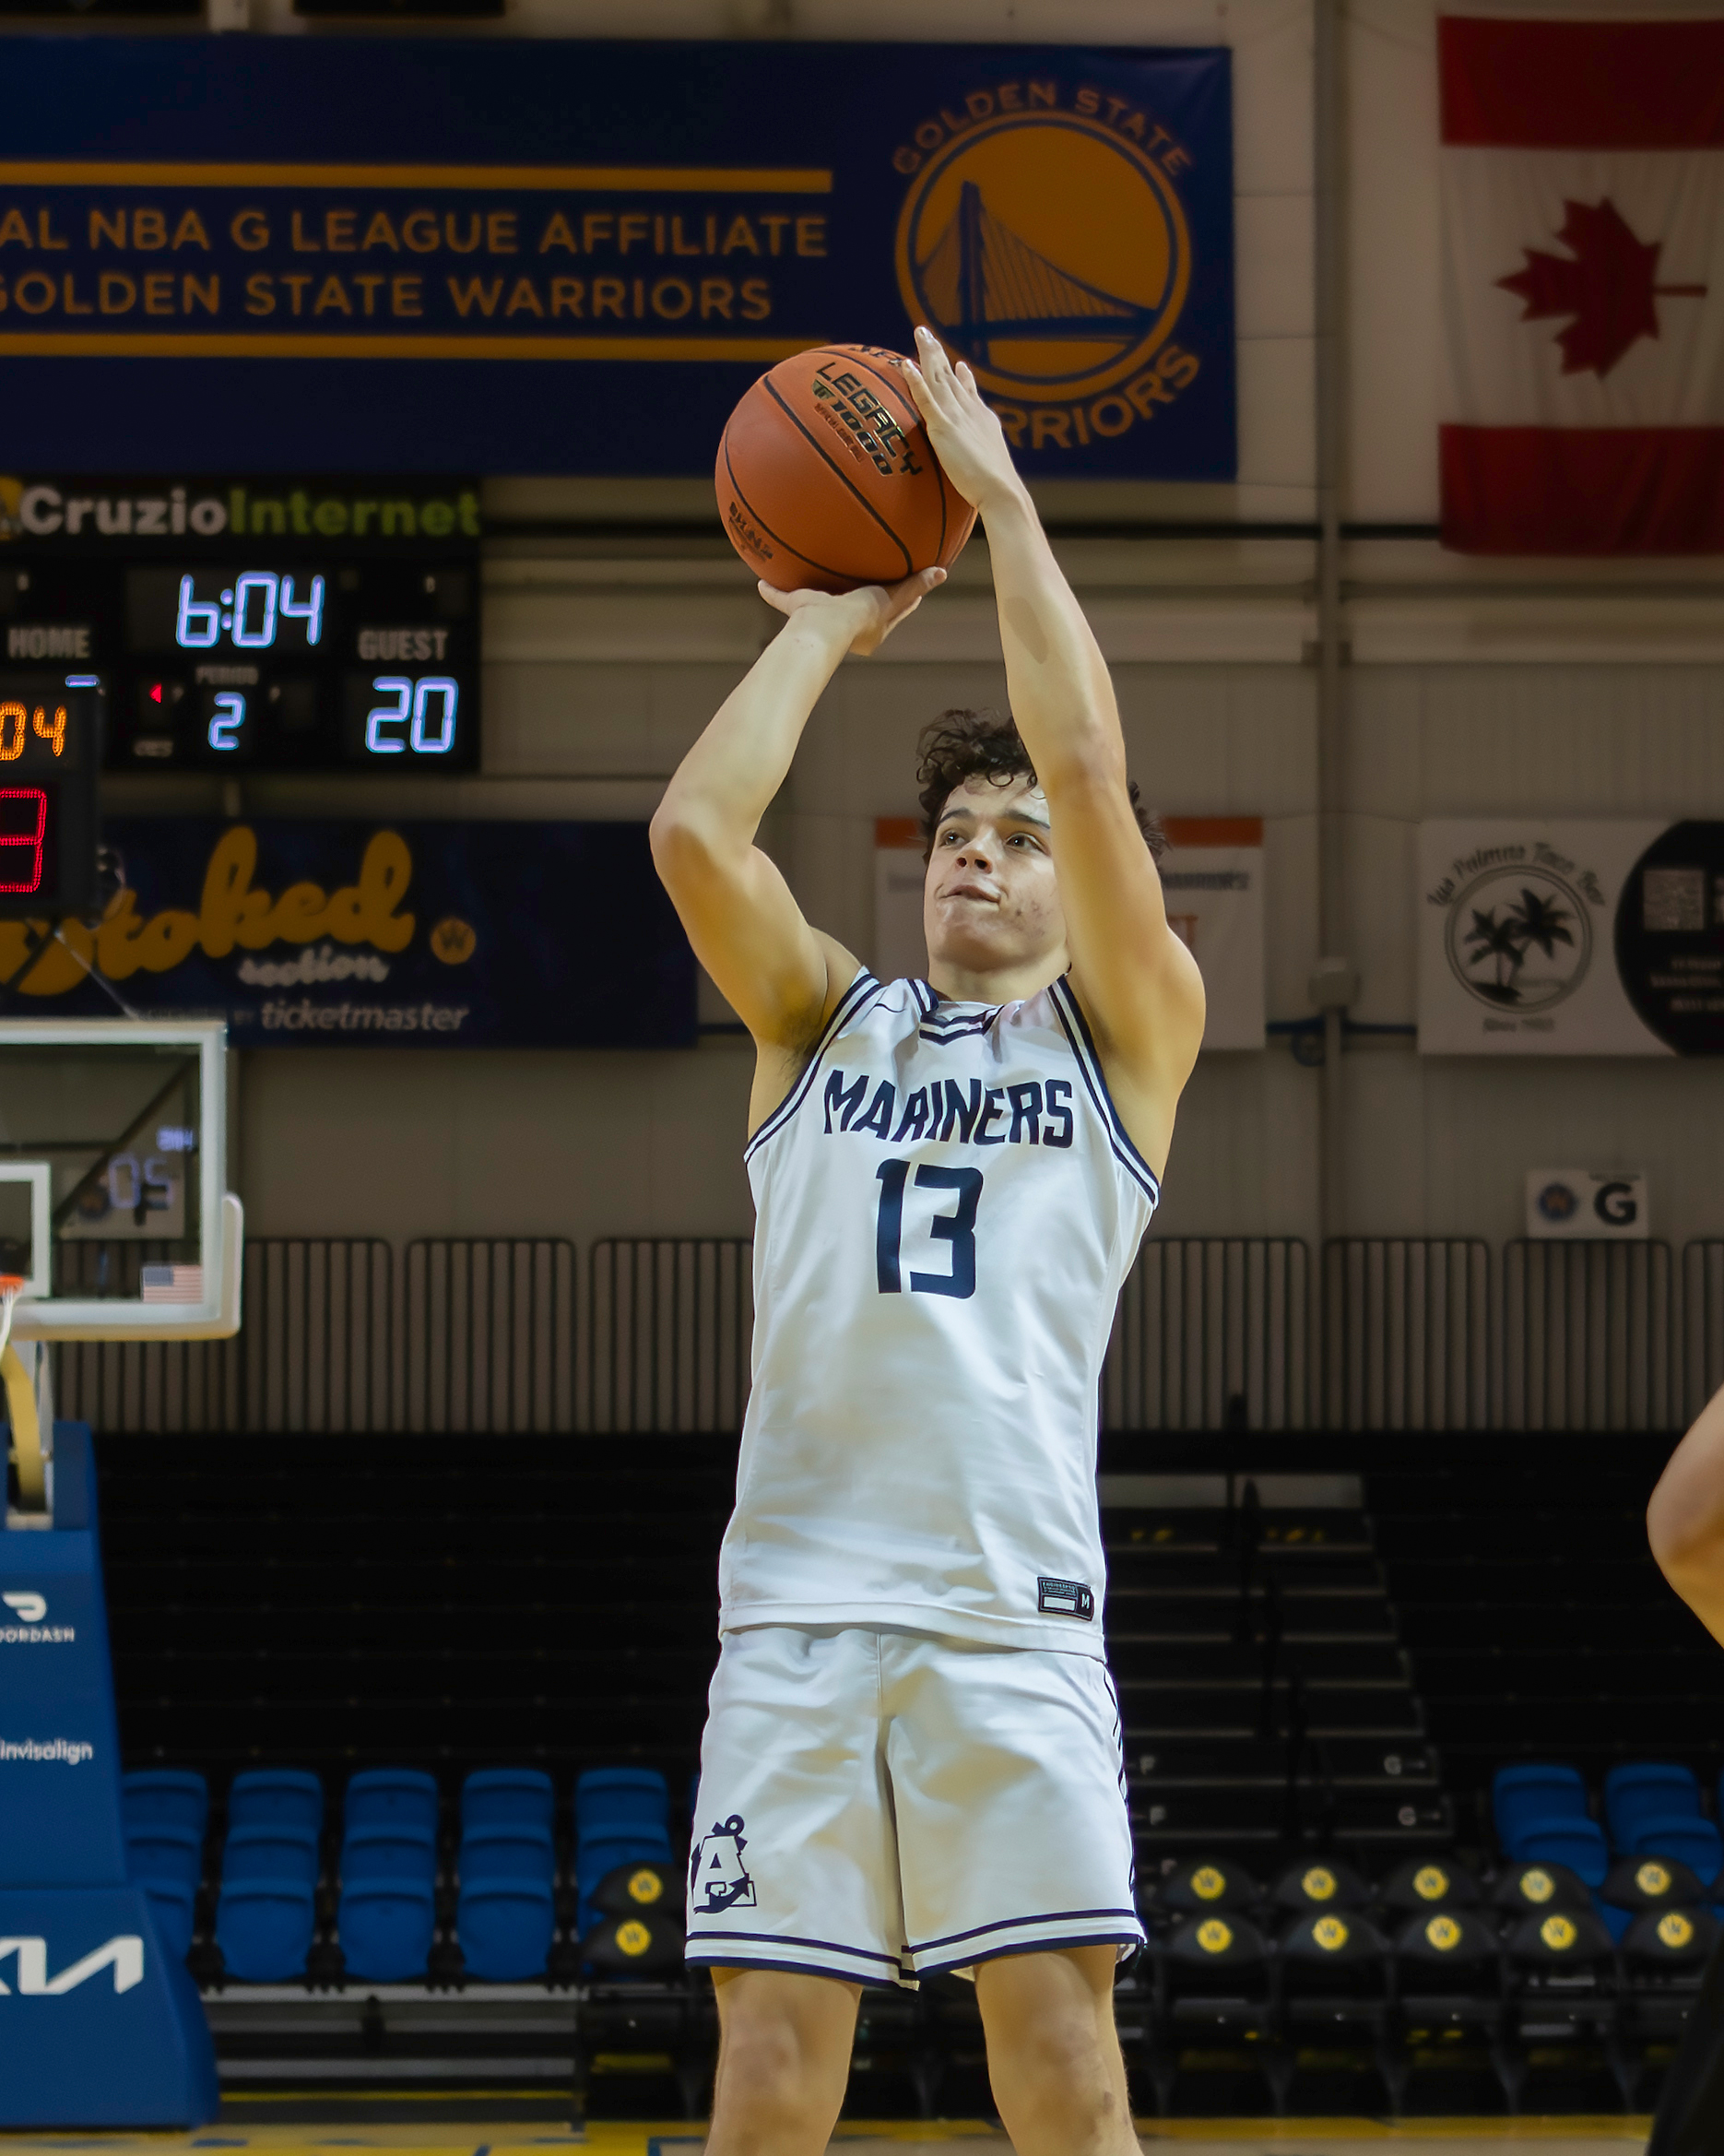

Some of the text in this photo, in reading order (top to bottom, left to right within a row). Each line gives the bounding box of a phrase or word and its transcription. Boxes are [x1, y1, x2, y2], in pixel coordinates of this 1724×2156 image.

[893, 80, 1192, 175] GOLDEN STATE
[89, 207, 212, 251] NBA
[230, 209, 271, 253] G
[291, 209, 519, 255] LEAGUE
[538, 210, 829, 257] AFFILIATE
[0, 272, 773, 321] OLDEN STATE WARRIORS
[816, 361, 922, 476] LEGACY
[175, 571, 325, 648] 6:04
[7, 626, 90, 659] HOME
[357, 628, 450, 661] GUEST
[208, 692, 246, 751] 2
[365, 676, 459, 753] 20
[261, 998, 469, 1032] ticketmaster
[823, 1069, 1073, 1149] MARINERS
[875, 1158, 984, 1299] 13
[1594, 1182, 1636, 1226] G
[0, 1627, 75, 1643] ORDASH
